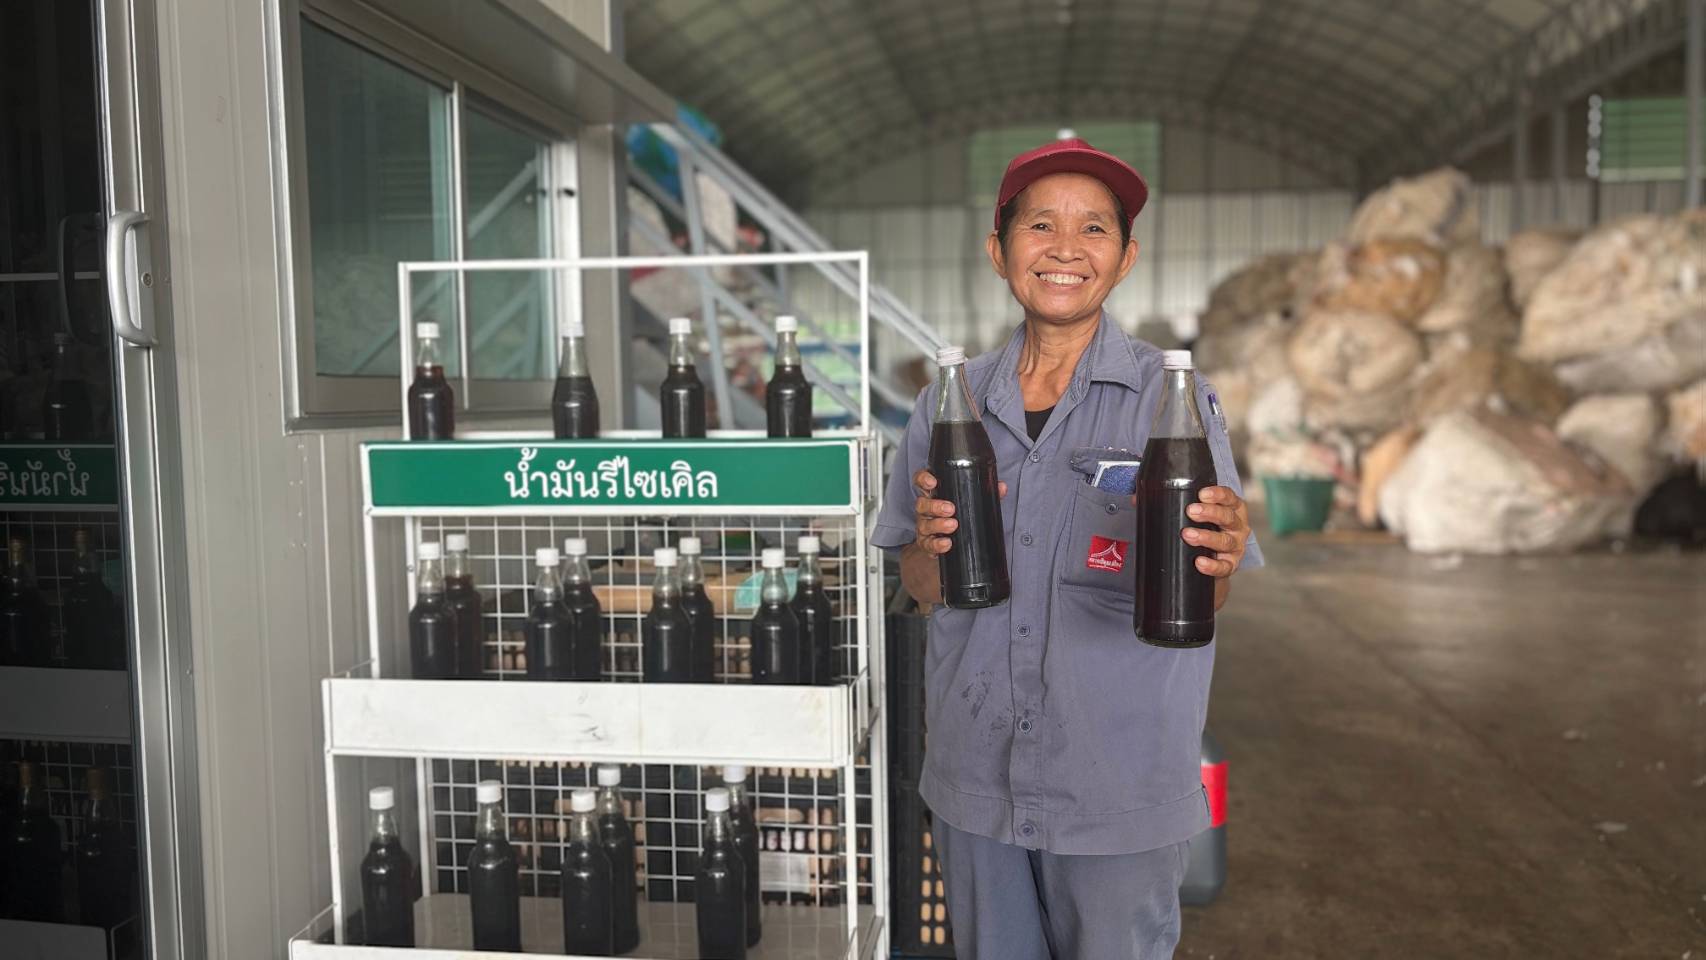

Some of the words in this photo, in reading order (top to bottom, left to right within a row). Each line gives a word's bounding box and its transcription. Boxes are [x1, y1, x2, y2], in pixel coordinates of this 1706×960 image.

[503, 447, 719, 498] น้ำมันรีไซเคิล
